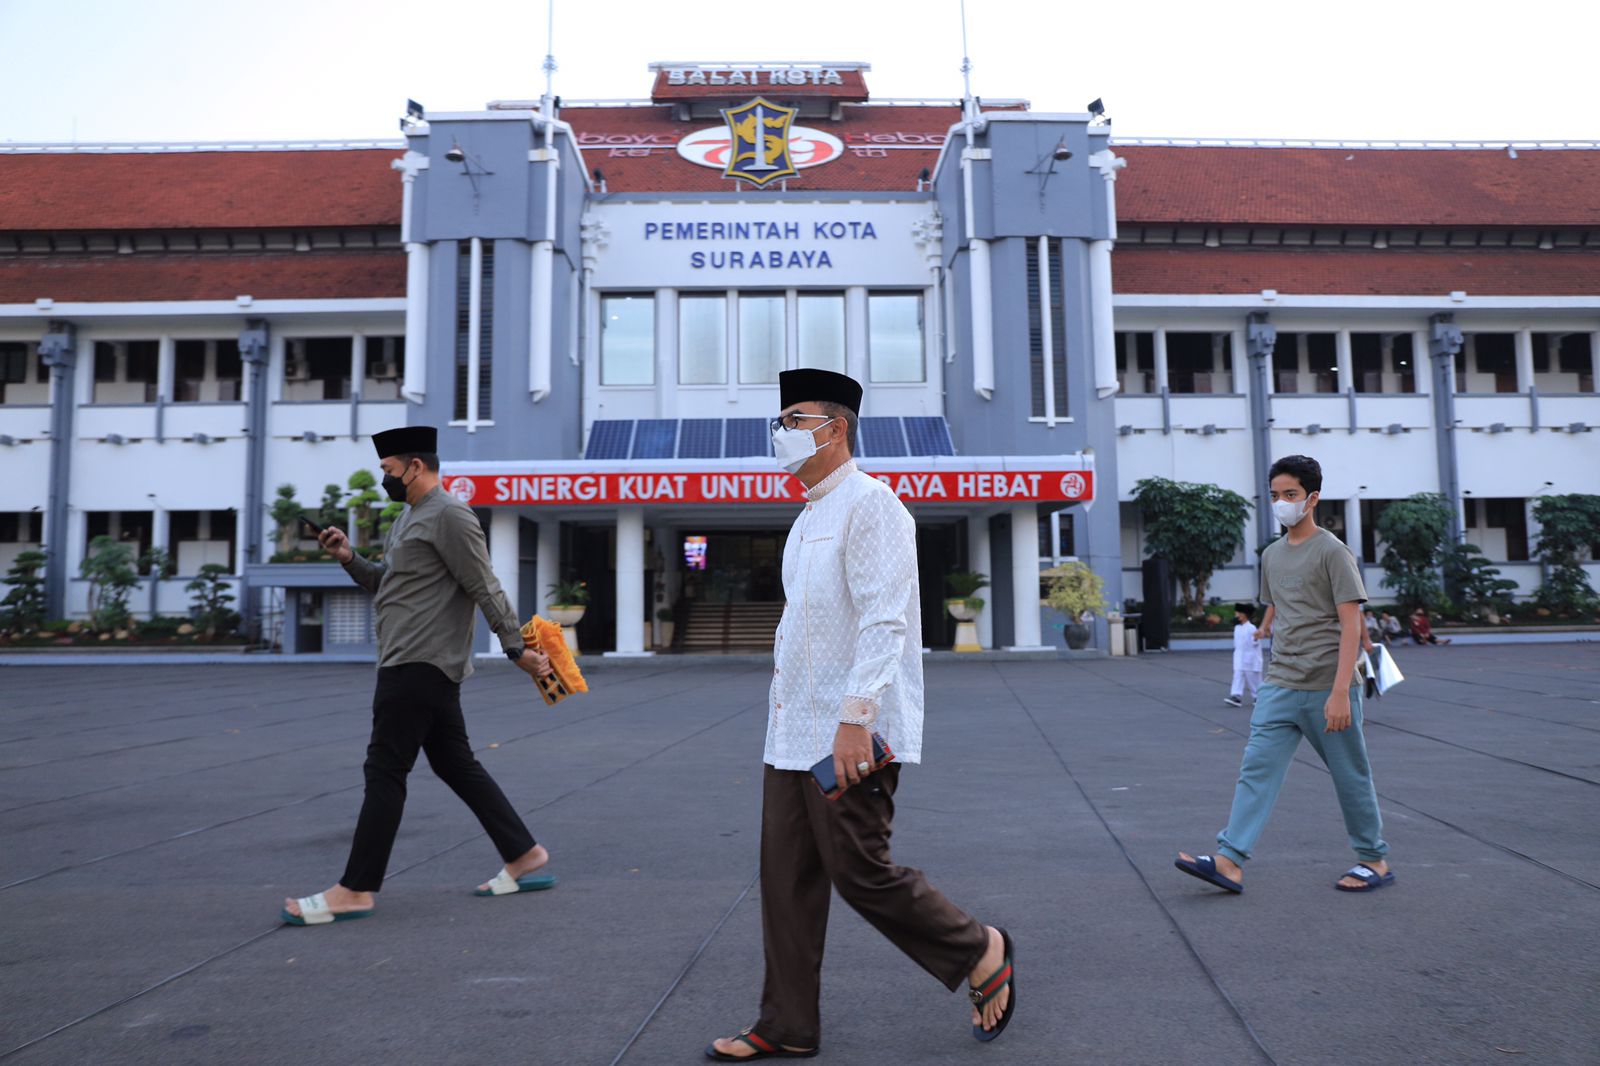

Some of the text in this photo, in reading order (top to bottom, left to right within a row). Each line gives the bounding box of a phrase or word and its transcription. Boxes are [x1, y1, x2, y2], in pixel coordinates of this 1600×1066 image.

[668, 69, 844, 85] BALAI KOTA
[644, 221, 878, 241] PEMERINTAH KOTA
[690, 250, 833, 269] SURABAYA
[494, 475, 608, 501] SINERGI
[618, 475, 688, 500] KUAT
[700, 474, 792, 500] UNTUK
[957, 473, 1042, 497] HEBAT
